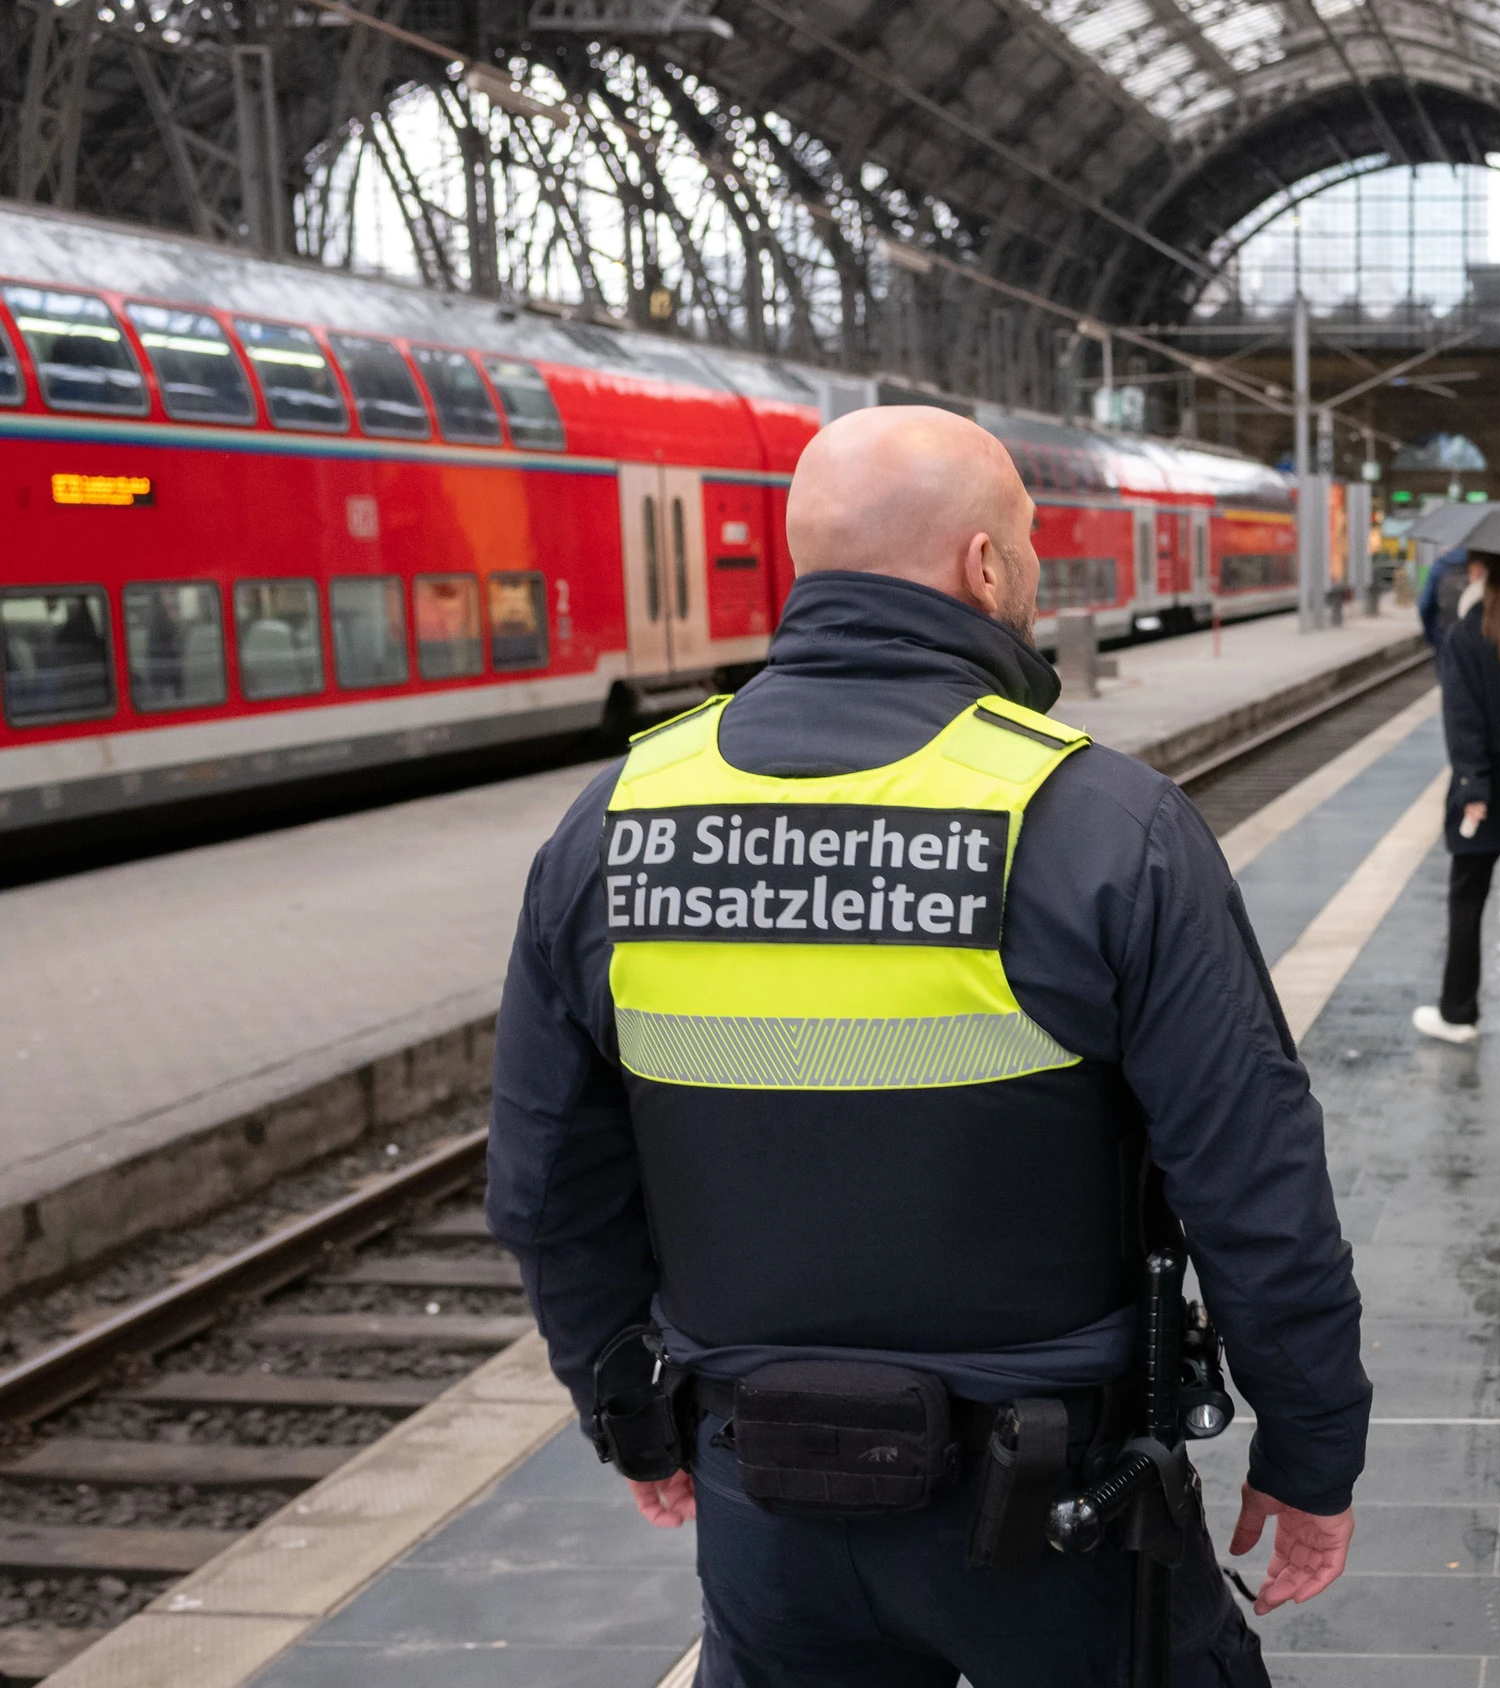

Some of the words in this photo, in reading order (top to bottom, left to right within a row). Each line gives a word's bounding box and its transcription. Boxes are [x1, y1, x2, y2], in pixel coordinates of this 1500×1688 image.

[607, 818, 677, 866] DB
[692, 814, 990, 873] Sicherheit
[606, 871, 987, 935] Einsatzleiter
